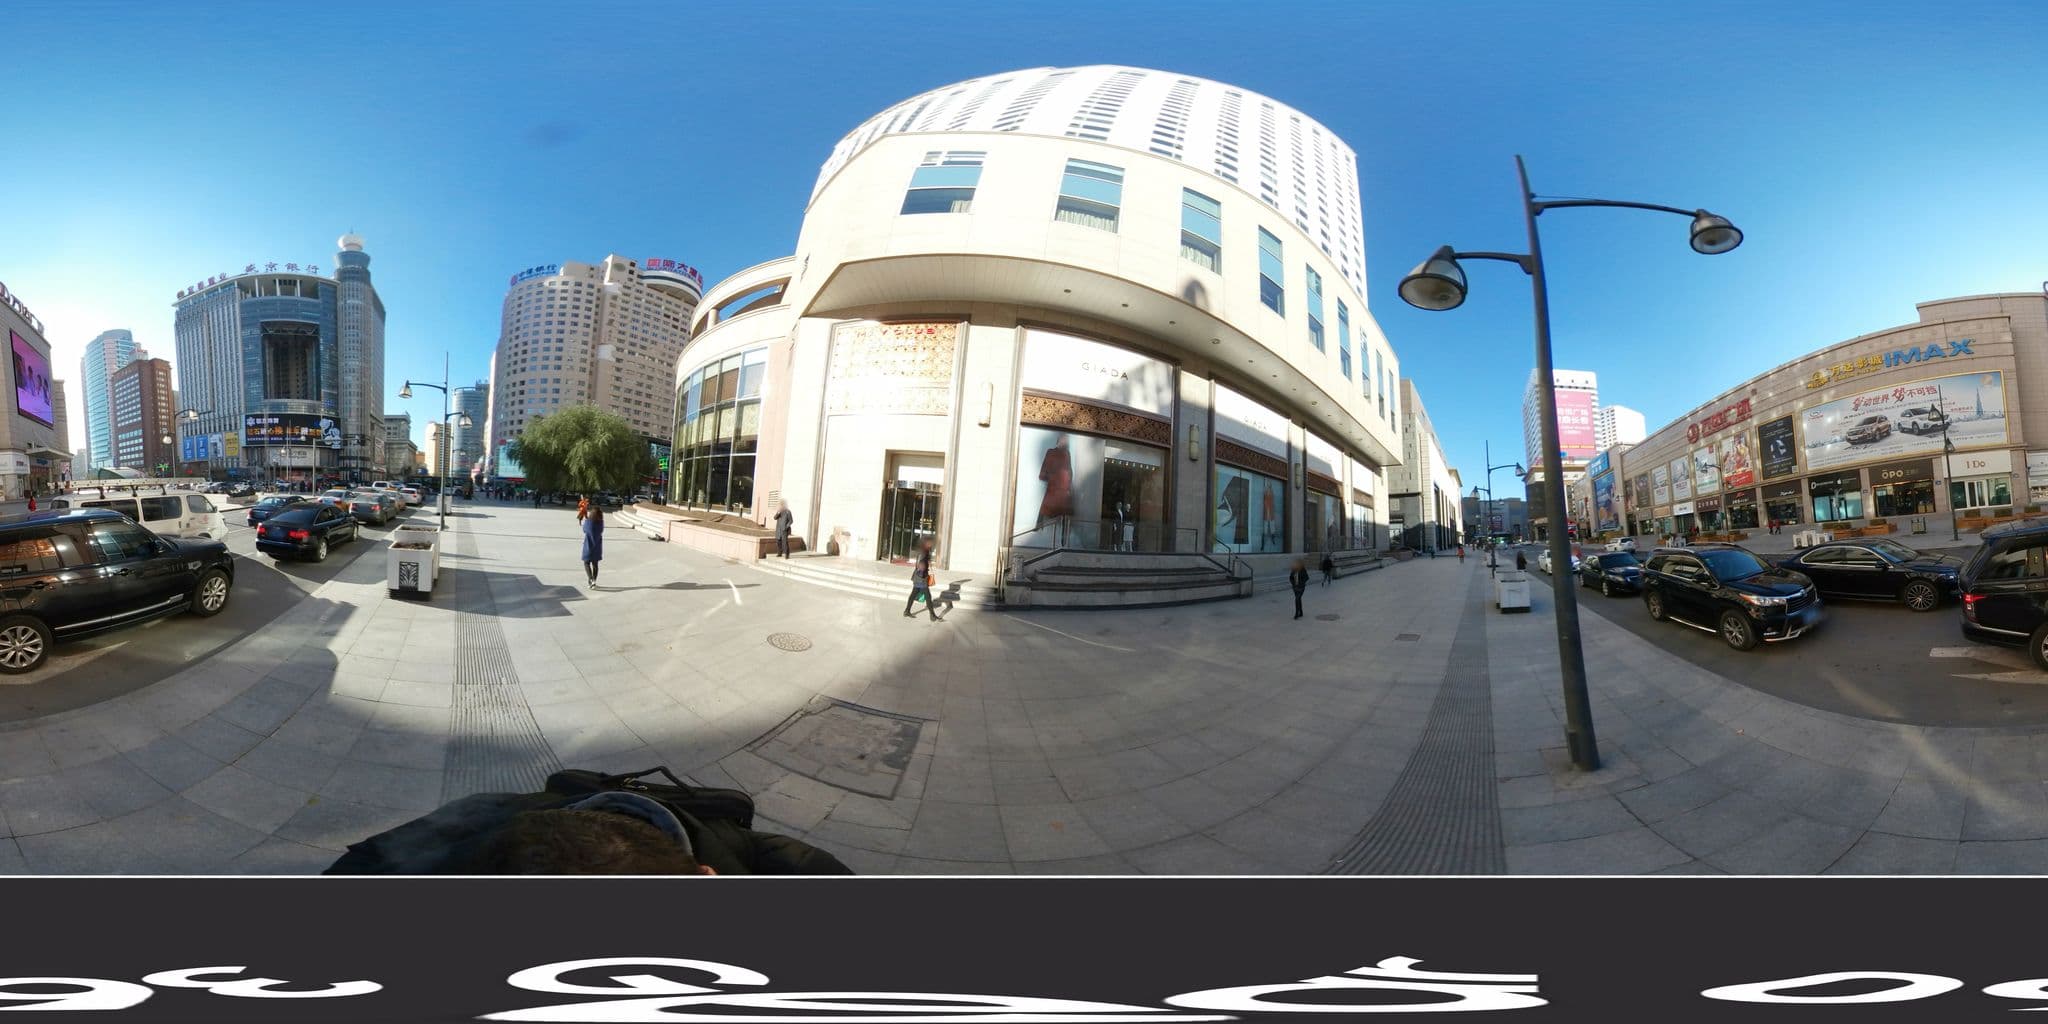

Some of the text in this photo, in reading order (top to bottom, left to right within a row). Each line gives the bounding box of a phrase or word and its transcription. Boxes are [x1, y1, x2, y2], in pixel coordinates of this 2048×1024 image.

[1884, 339, 1974, 368] IMAX
[1081, 361, 1129, 381] GIADA
[1829, 354, 1883, 377] 万达影城
[1973, 460, 1986, 468] Do
